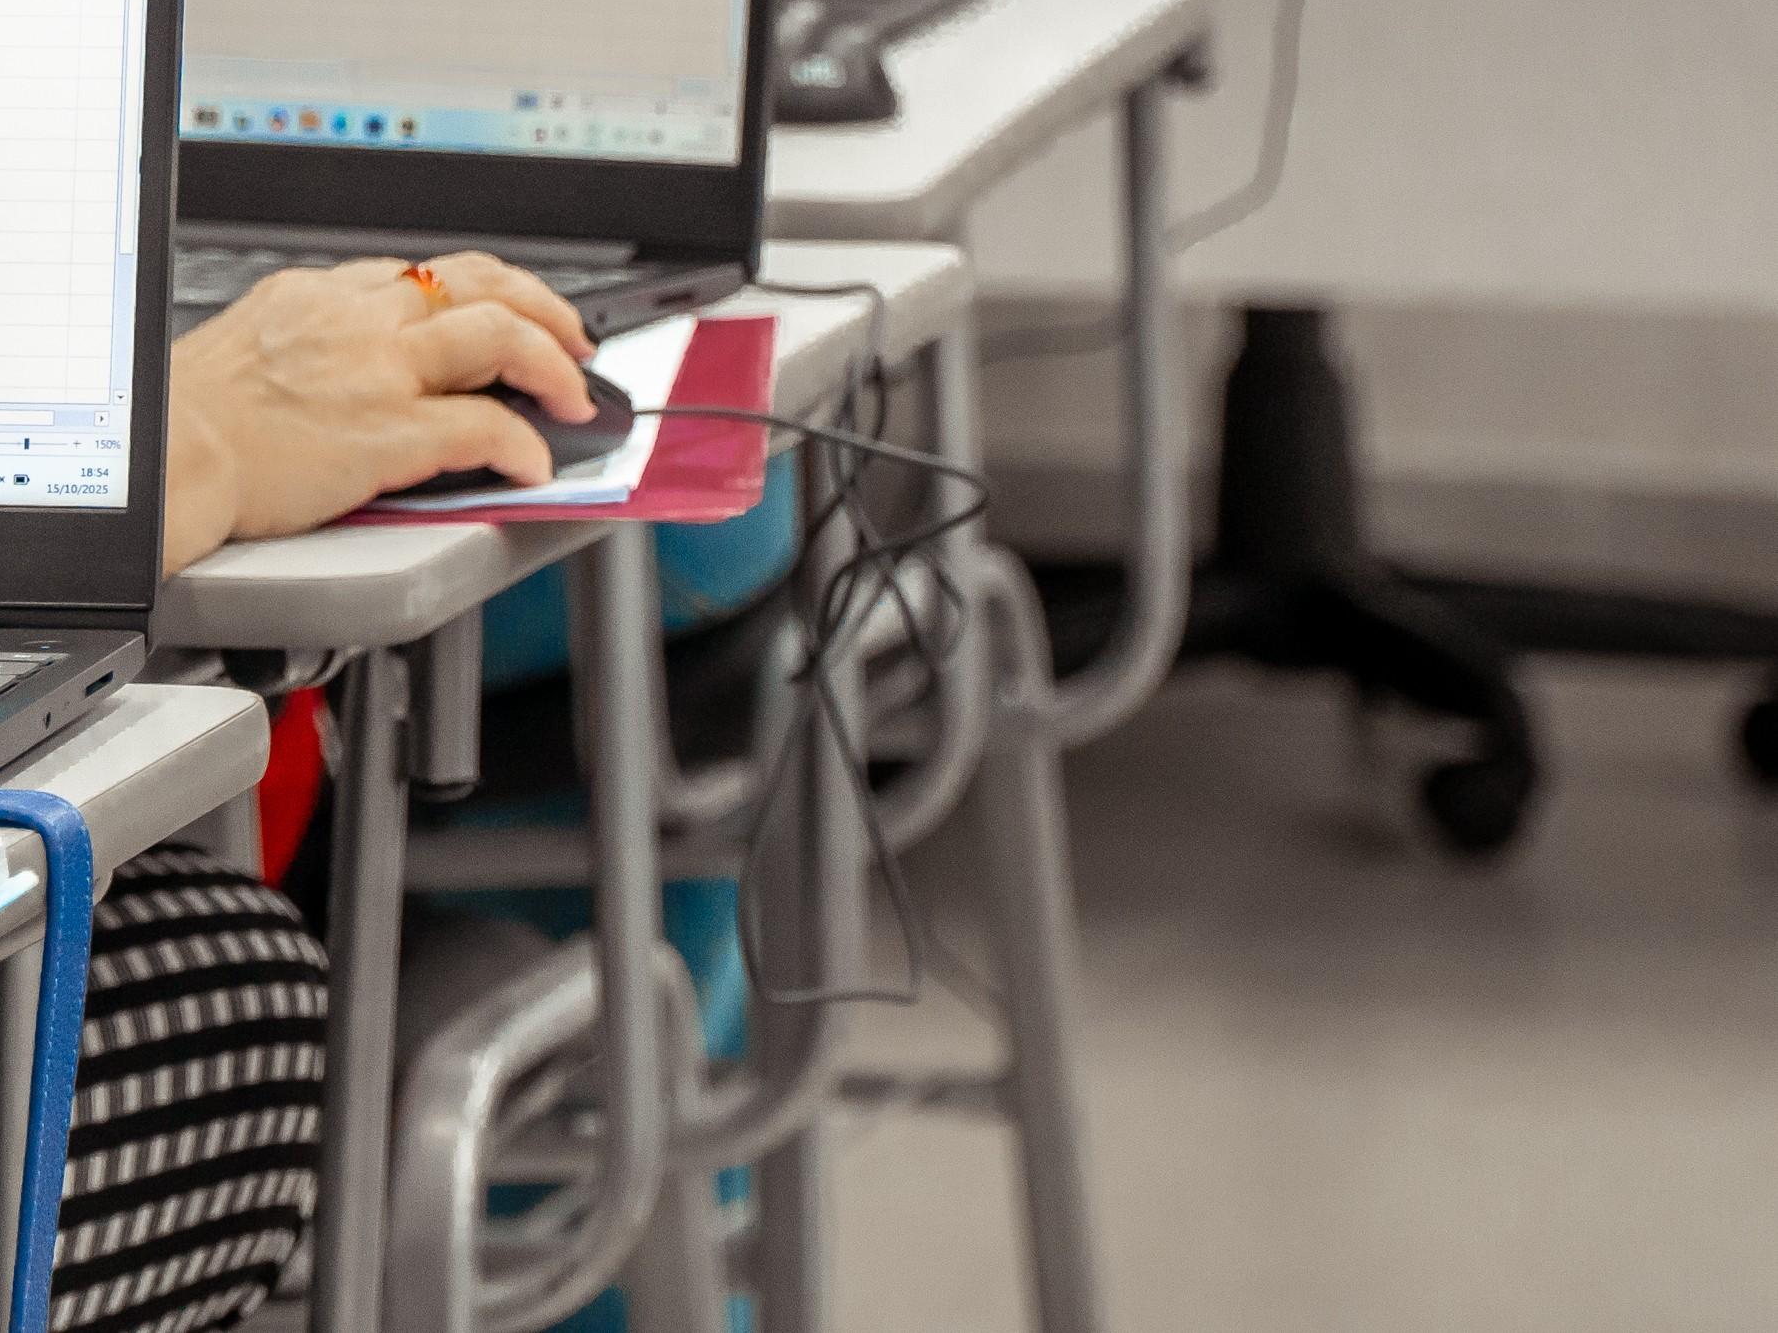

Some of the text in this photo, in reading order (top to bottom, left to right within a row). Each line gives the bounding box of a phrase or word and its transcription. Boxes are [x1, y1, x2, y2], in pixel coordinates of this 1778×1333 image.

[95, 440, 121, 450] 150%
[81, 468, 109, 478] 18:54
[47, 484, 109, 496] 15/10/2025
